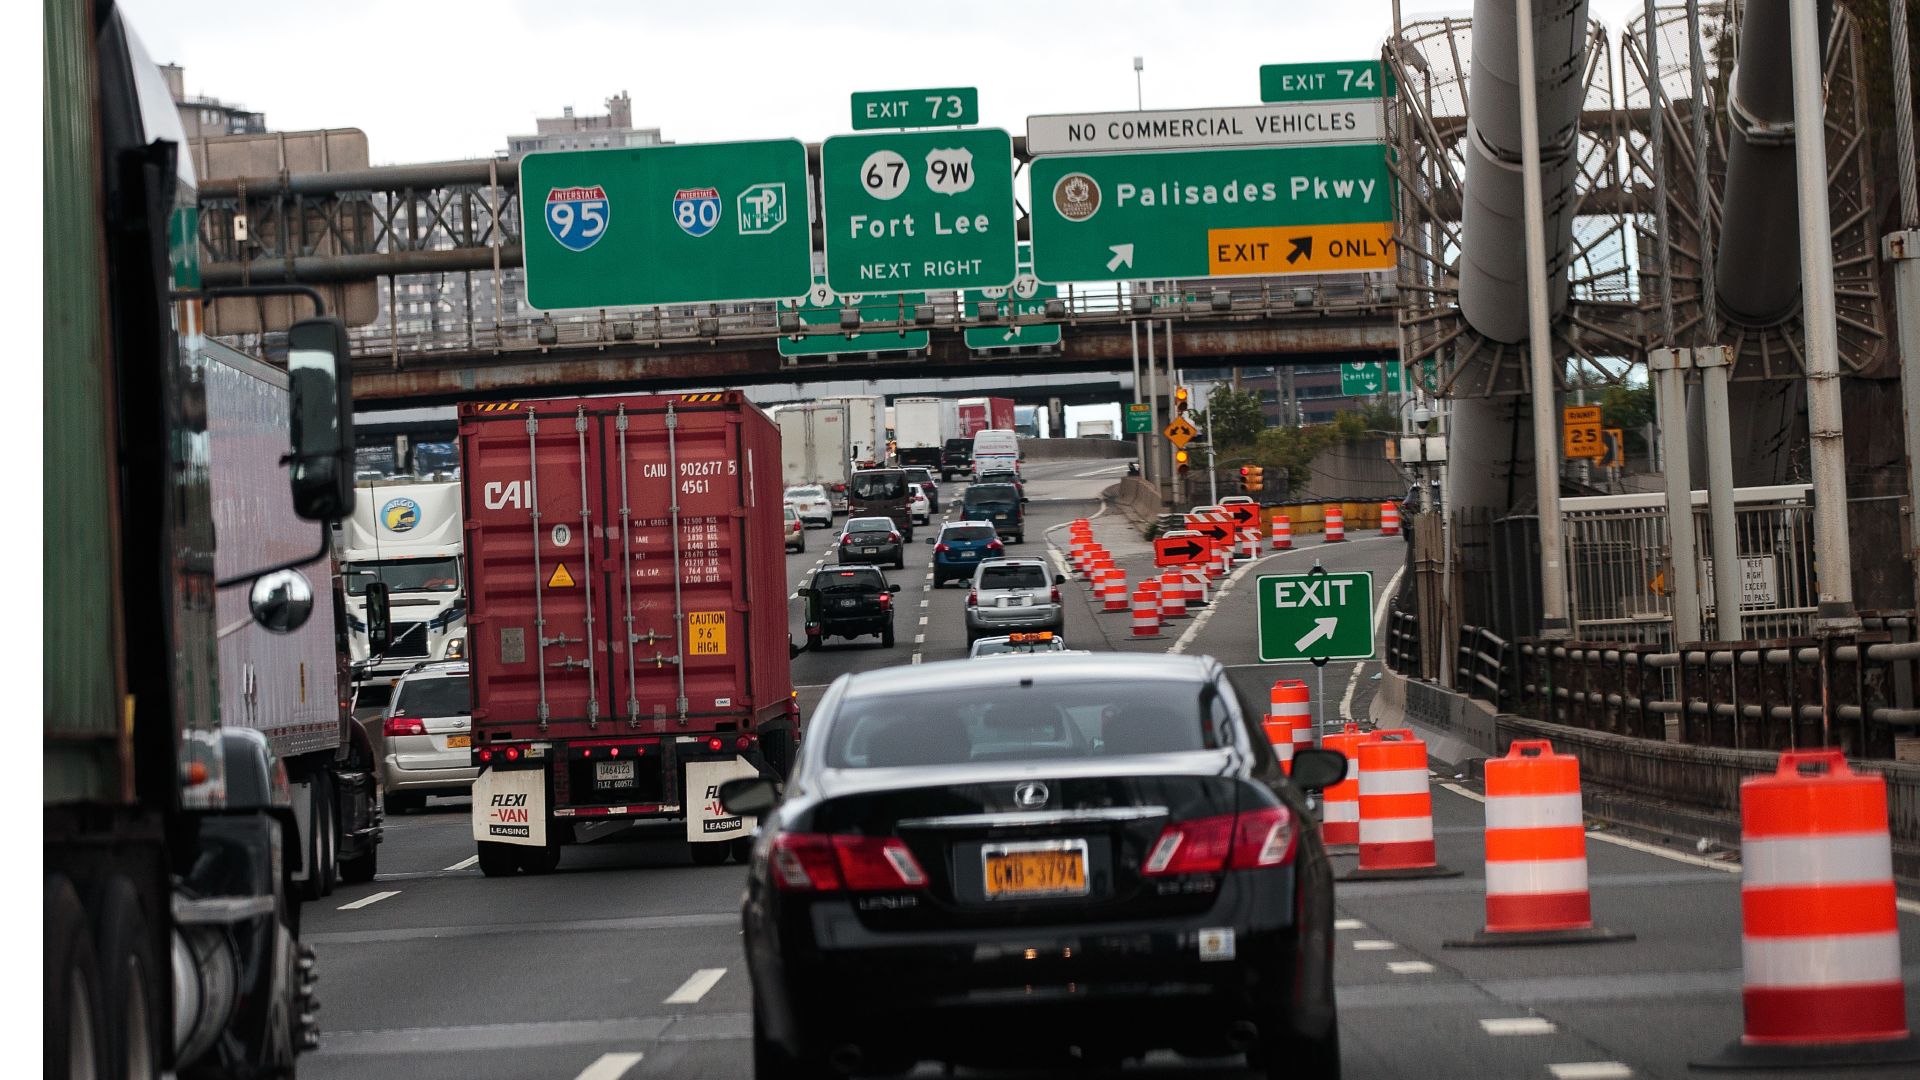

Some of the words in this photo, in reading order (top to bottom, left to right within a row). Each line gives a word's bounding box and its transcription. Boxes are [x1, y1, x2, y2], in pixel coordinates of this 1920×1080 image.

[1282, 74, 1326, 91] EXIT
[1336, 68, 1375, 92] 74
[866, 101, 909, 118] EXIT
[925, 95, 963, 119] 73
[1068, 123, 1096, 142] NO
[1108, 116, 1244, 140] COMMERCIAL
[1255, 112, 1356, 134] VEHICLES
[866, 162, 904, 189] 67
[930, 160, 968, 185] 9W
[554, 190, 599, 201] INTERSTATE
[680, 190, 714, 199] INTERSTATE
[1117, 179, 1277, 207] Palisades
[1290, 175, 1376, 203] Pkwy
[551, 202, 604, 239] 95
[678, 201, 718, 229] 80
[850, 213, 915, 239] Fort
[934, 212, 990, 235] Lee
[1217, 243, 1270, 263] EXIT
[1328, 238, 1392, 259] ONLY
[860, 263, 911, 280] NEXT
[924, 259, 983, 277] RIGHT
[1016, 280, 1035, 294] 67
[817, 289, 826, 302] 9
[1018, 304, 1045, 315] Lee
[1343, 371, 1375, 381] Center
[1571, 429, 1598, 444] 25
[643, 463, 667, 478] CAIU
[680, 461, 722, 476] 902677
[728, 460, 736, 475] 5
[681, 480, 709, 494] 45G1
[484, 480, 532, 510] CAI
[386, 499, 415, 512] ARGO
[635, 536, 649, 544] TARE
[1275, 579, 1353, 608] EXIT
[1743, 594, 1751, 602] TO
[689, 613, 725, 625] CAUTION
[697, 642, 719, 653] HIGH
[490, 793, 528, 807] FLEXI
[490, 808, 528, 823] -VAN
[491, 827, 528, 836] LEASING
[704, 820, 741, 830] LEASING
